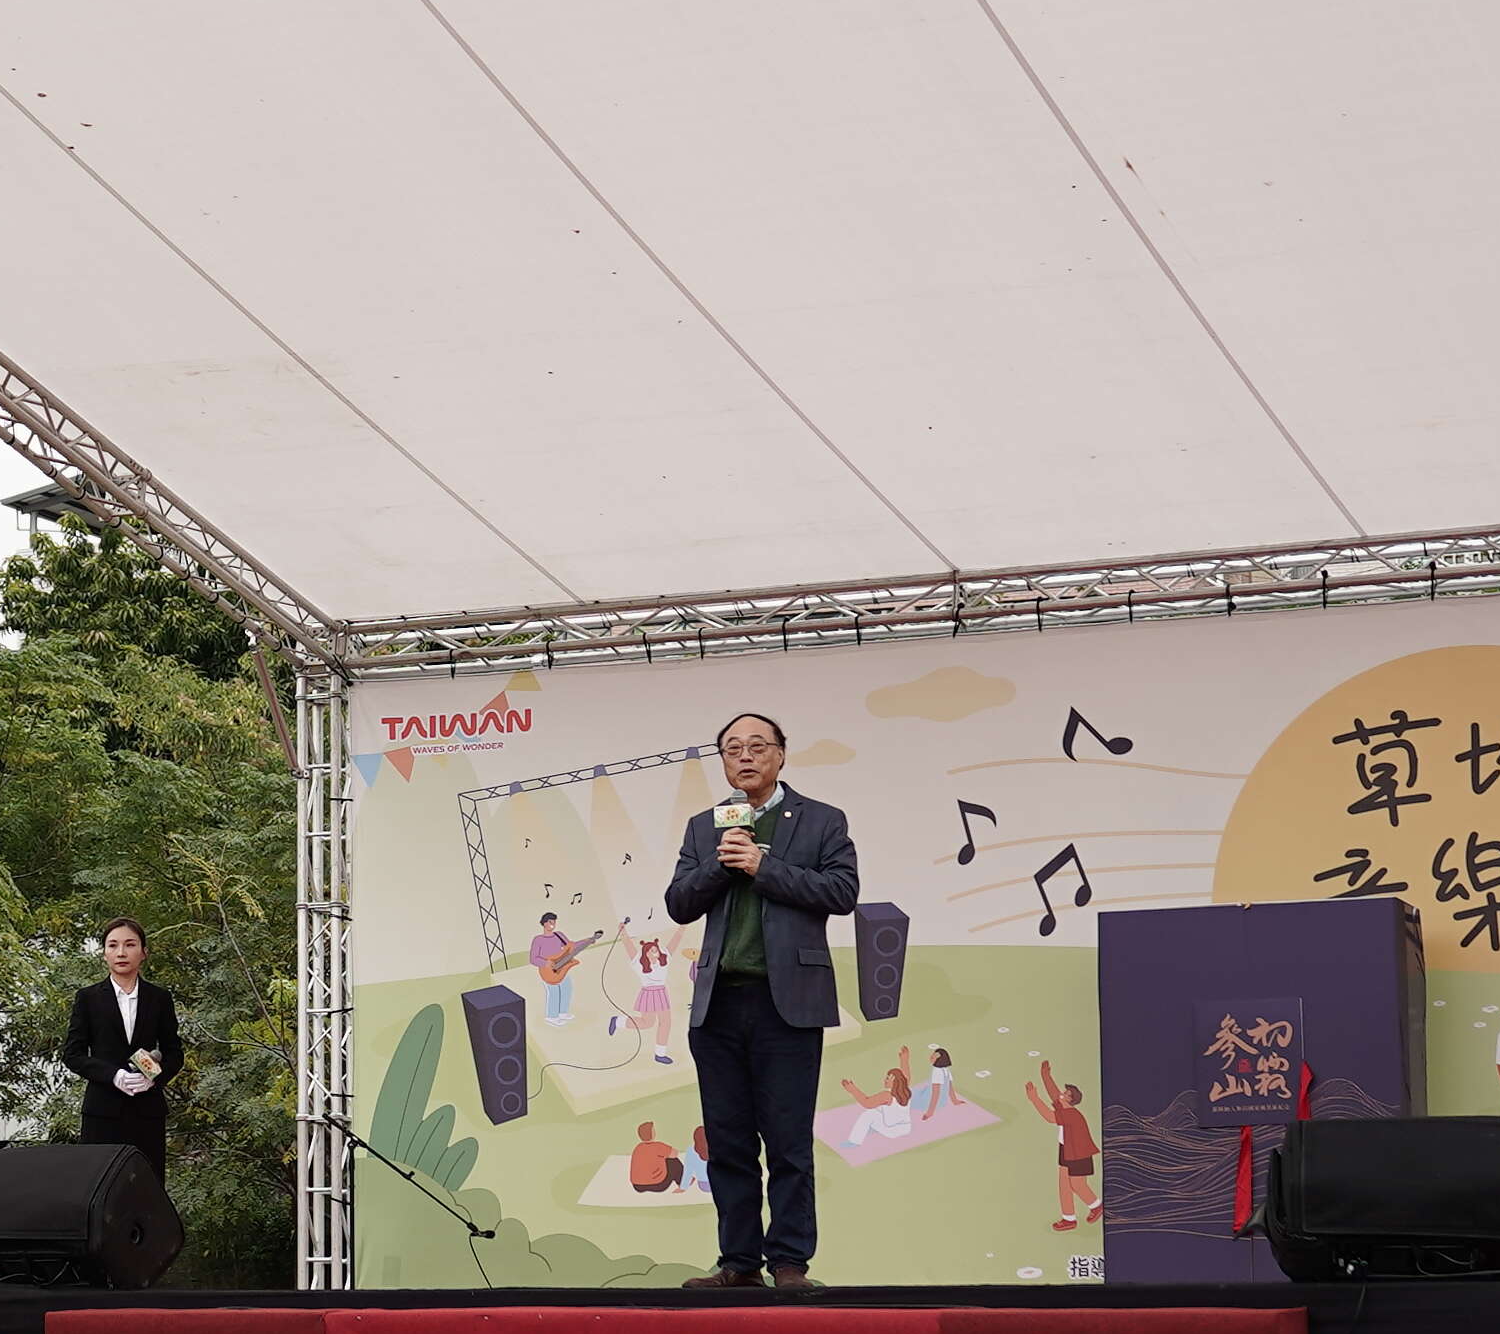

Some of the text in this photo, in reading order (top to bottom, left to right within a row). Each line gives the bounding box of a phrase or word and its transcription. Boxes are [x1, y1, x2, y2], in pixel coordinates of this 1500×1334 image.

[381, 708, 533, 741] TAIWAN
[413, 741, 504, 755] WAVES OF WONDER
